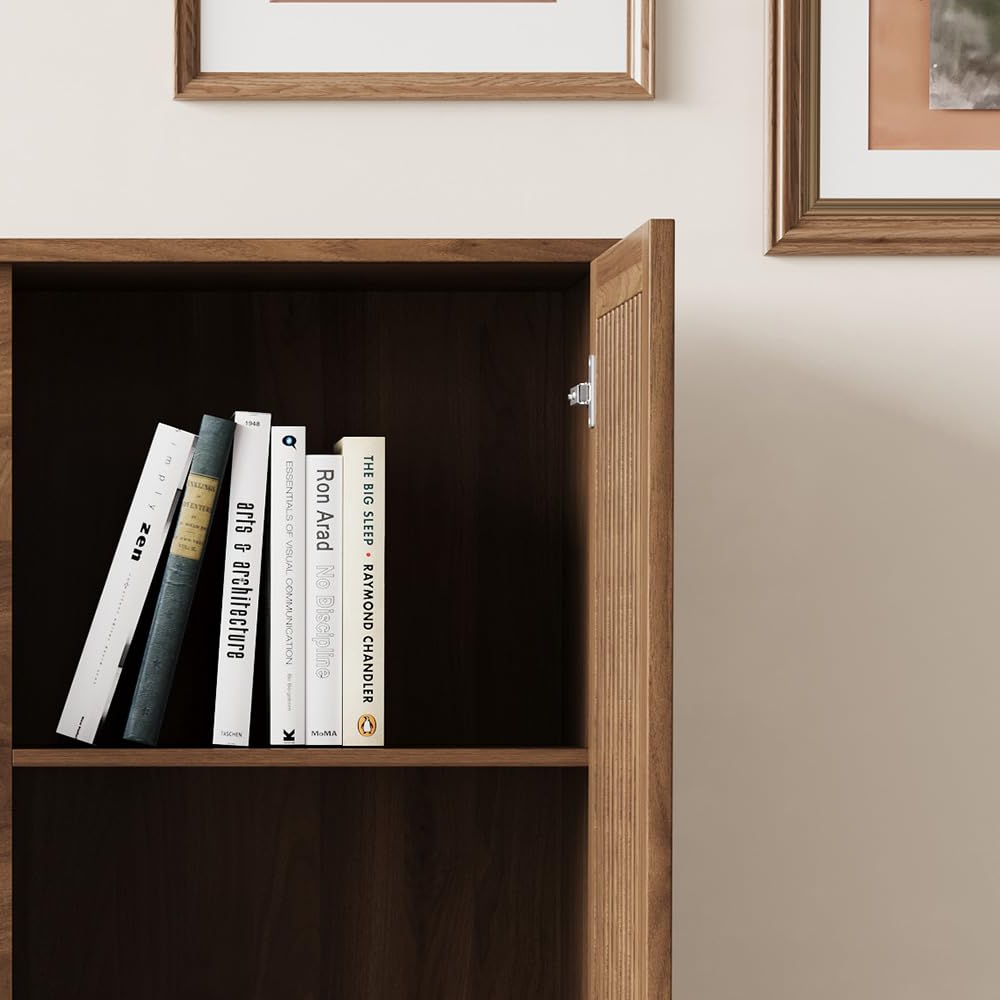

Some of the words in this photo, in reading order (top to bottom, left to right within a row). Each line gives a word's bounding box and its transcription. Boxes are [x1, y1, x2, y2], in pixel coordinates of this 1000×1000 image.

[363, 456, 374, 477] THE
[285, 461, 293, 521] ESSENTIALS
[316, 469, 334, 503] Ron
[363, 484, 374, 505] BIG
[235, 503, 255, 532] arts
[286, 524, 293, 537] OF
[316, 510, 334, 551] Arad
[363, 511, 374, 546] SLEEP
[131, 523, 151, 561] zen
[234, 544, 252, 552] &
[285, 540, 293, 574] VISUAL
[316, 565, 334, 589] No
[227, 561, 253, 658] architecture
[363, 564, 374, 630] RAYMOND
[285, 578, 293, 665] COMMUNICATION
[312, 595, 334, 678] Discipline
[362, 636, 374, 703] CHANDLER
